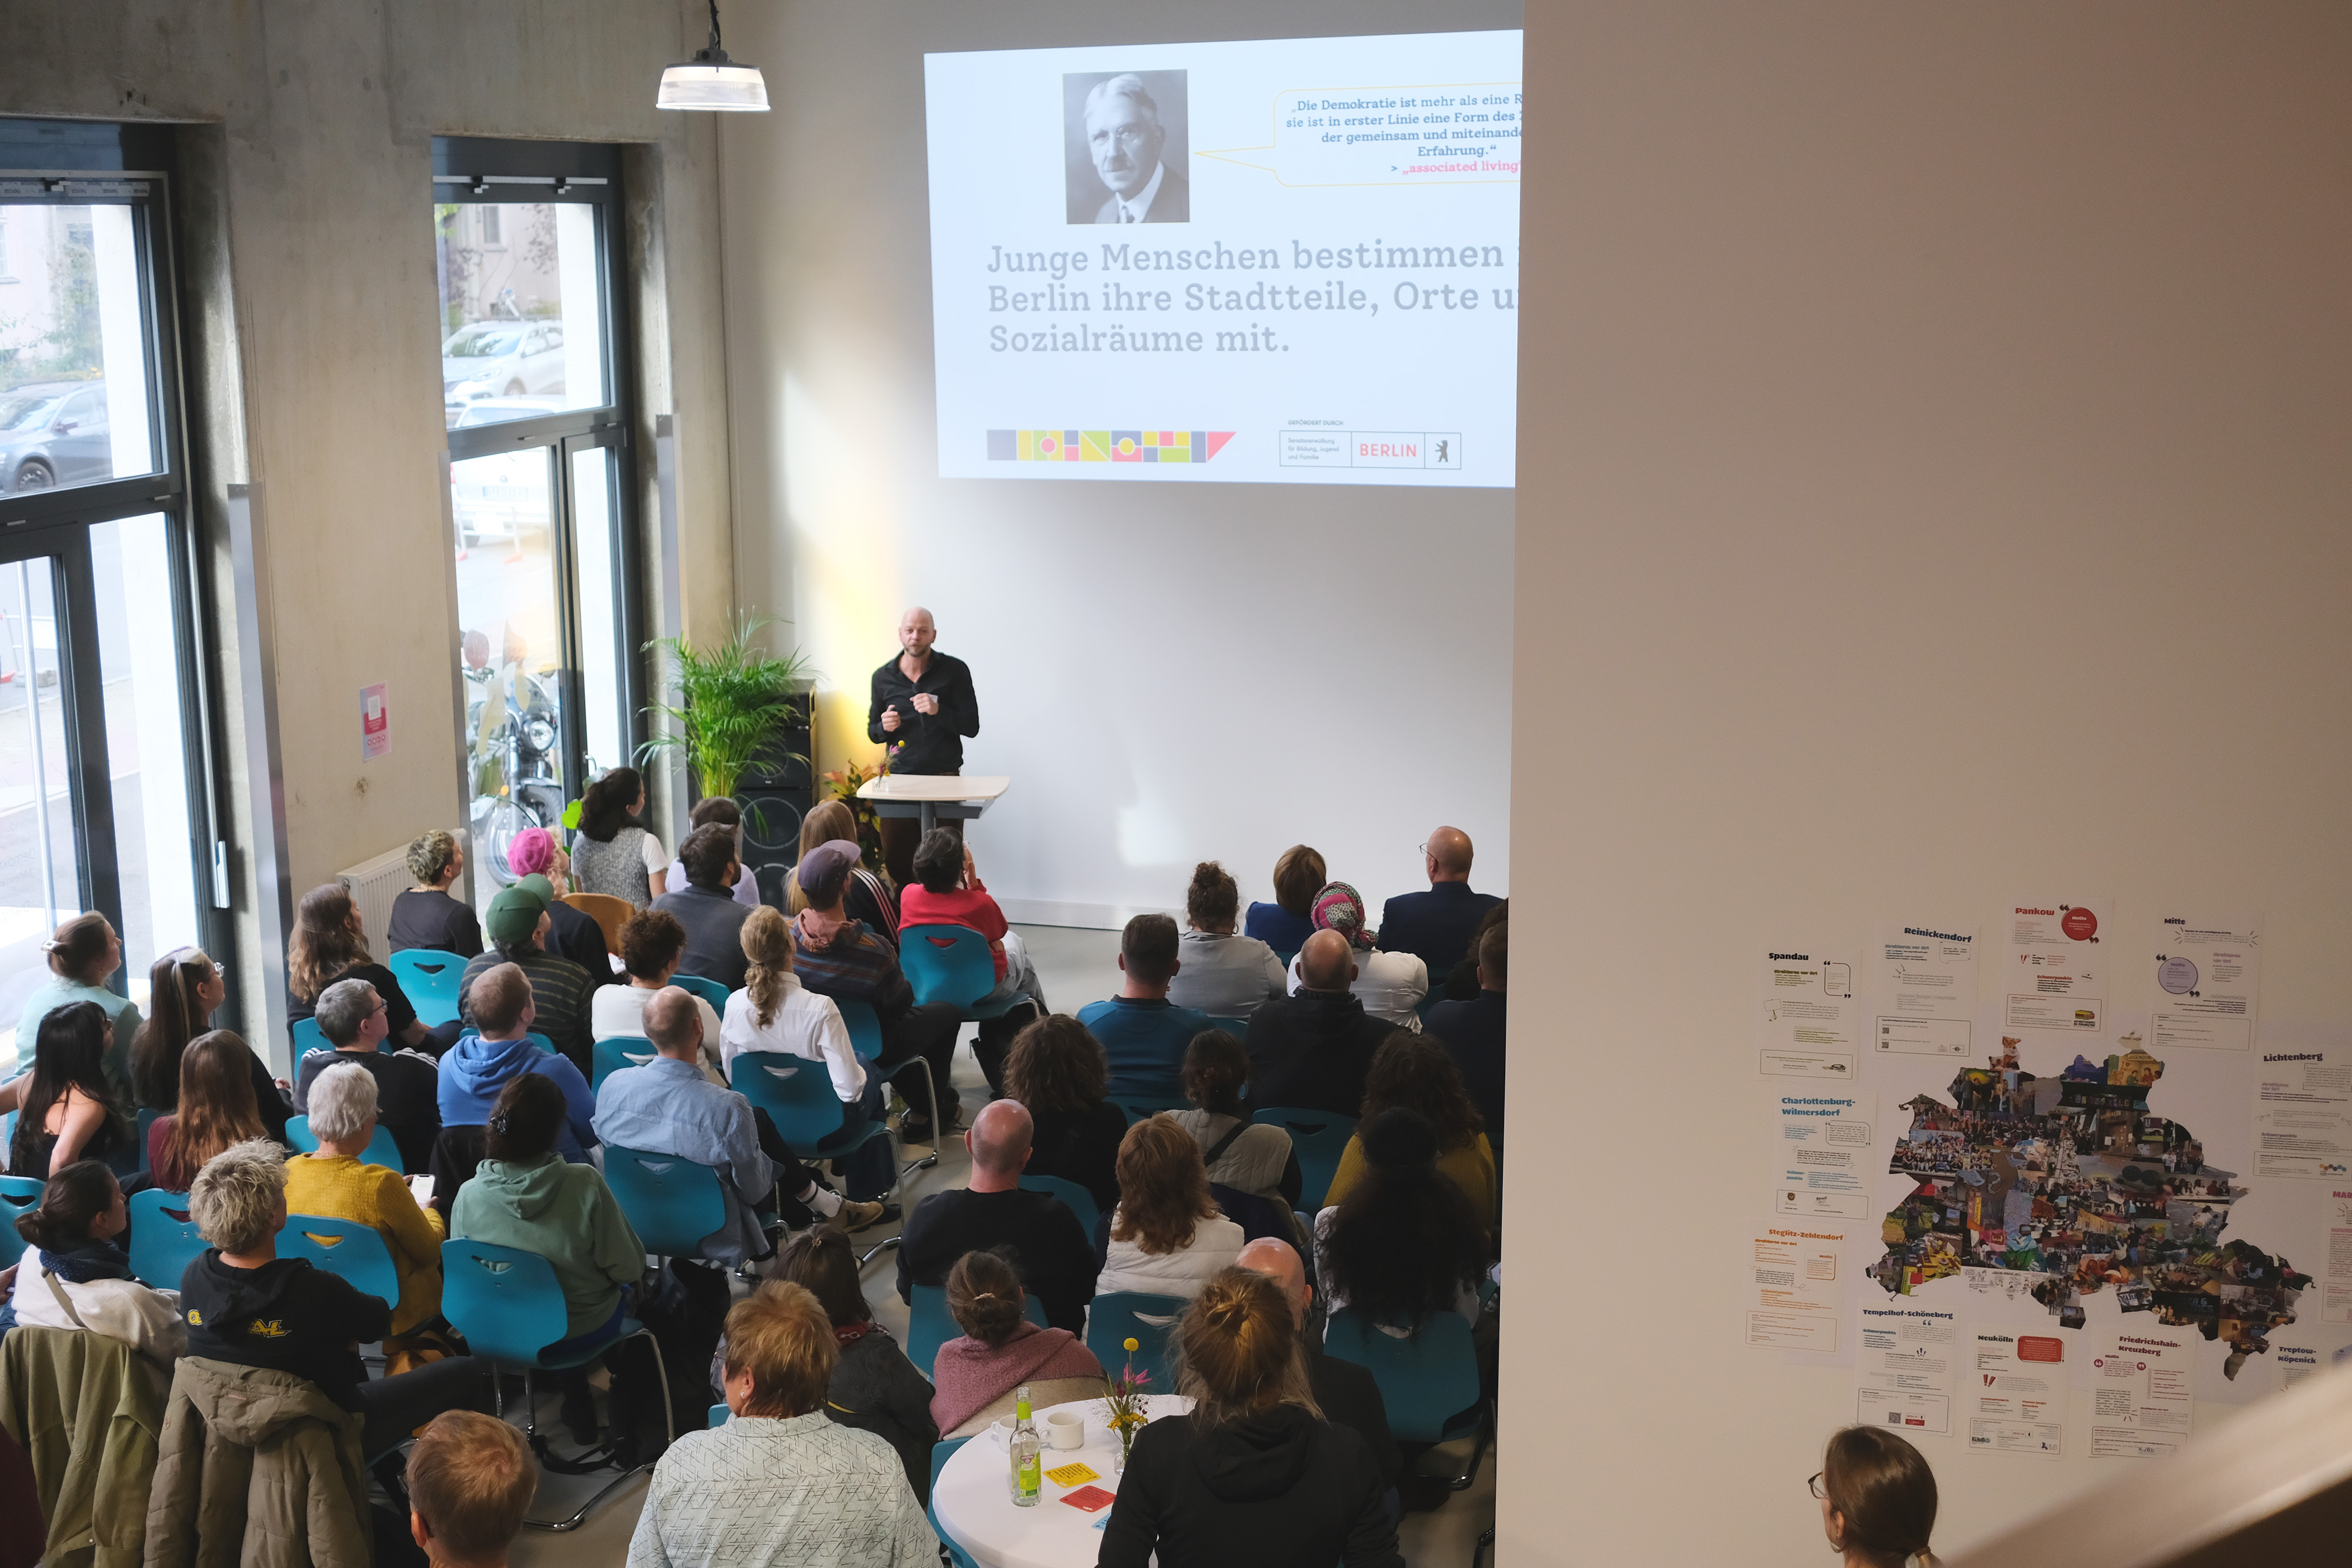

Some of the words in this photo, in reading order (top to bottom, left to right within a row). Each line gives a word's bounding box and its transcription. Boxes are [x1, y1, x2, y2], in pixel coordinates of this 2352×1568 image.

[1321, 98, 1396, 111] Demokratie
[1400, 96, 1418, 108] ist
[1421, 95, 1455, 108] mehr
[1459, 95, 1478, 106] als
[1482, 94, 1510, 105] eine
[1286, 117, 1304, 128] sie
[1308, 116, 1324, 127] ist
[1328, 115, 1341, 126] in
[1344, 115, 1384, 126] erster
[1388, 114, 1419, 125] Linie
[1423, 113, 1451, 123] eine
[1454, 112, 1489, 123] Form
[1492, 111, 1515, 121] des
[1321, 132, 1342, 143] der
[1346, 130, 1419, 145] gemeinsam
[1423, 128, 1448, 140] und
[987, 245, 1088, 280] Junge
[1101, 240, 1279, 271] Menschen
[1292, 238, 1504, 269] bestimmen
[988, 283, 1090, 312] Berlin
[1102, 282, 1171, 311] ihre
[1184, 280, 1378, 317] Stadtteile,
[1394, 280, 1479, 310] Orte
[990, 323, 1203, 352] Sozialräume
[1215, 322, 1289, 352] mit.
[1359, 443, 1416, 457] BERLIN
[2015, 907, 2055, 915] Pankow
[1904, 927, 1972, 943] Reinickendorf
[1769, 952, 1809, 961] Spandau
[2263, 1053, 2323, 1062] Lichtenberg
[1782, 1097, 1856, 1107] Charlottenburg-
[1782, 1108, 1840, 1116] Wilmersdorf
[1769, 1229, 1843, 1241] Steglitz-Zehlendorf
[1863, 1309, 1953, 1320] Tempelhof-Schöneberg
[2119, 1336, 2181, 1348] Friedrichshain-
[2119, 1345, 2161, 1357] Kreuzberg
[2278, 1355, 2316, 1364] Köpenick
